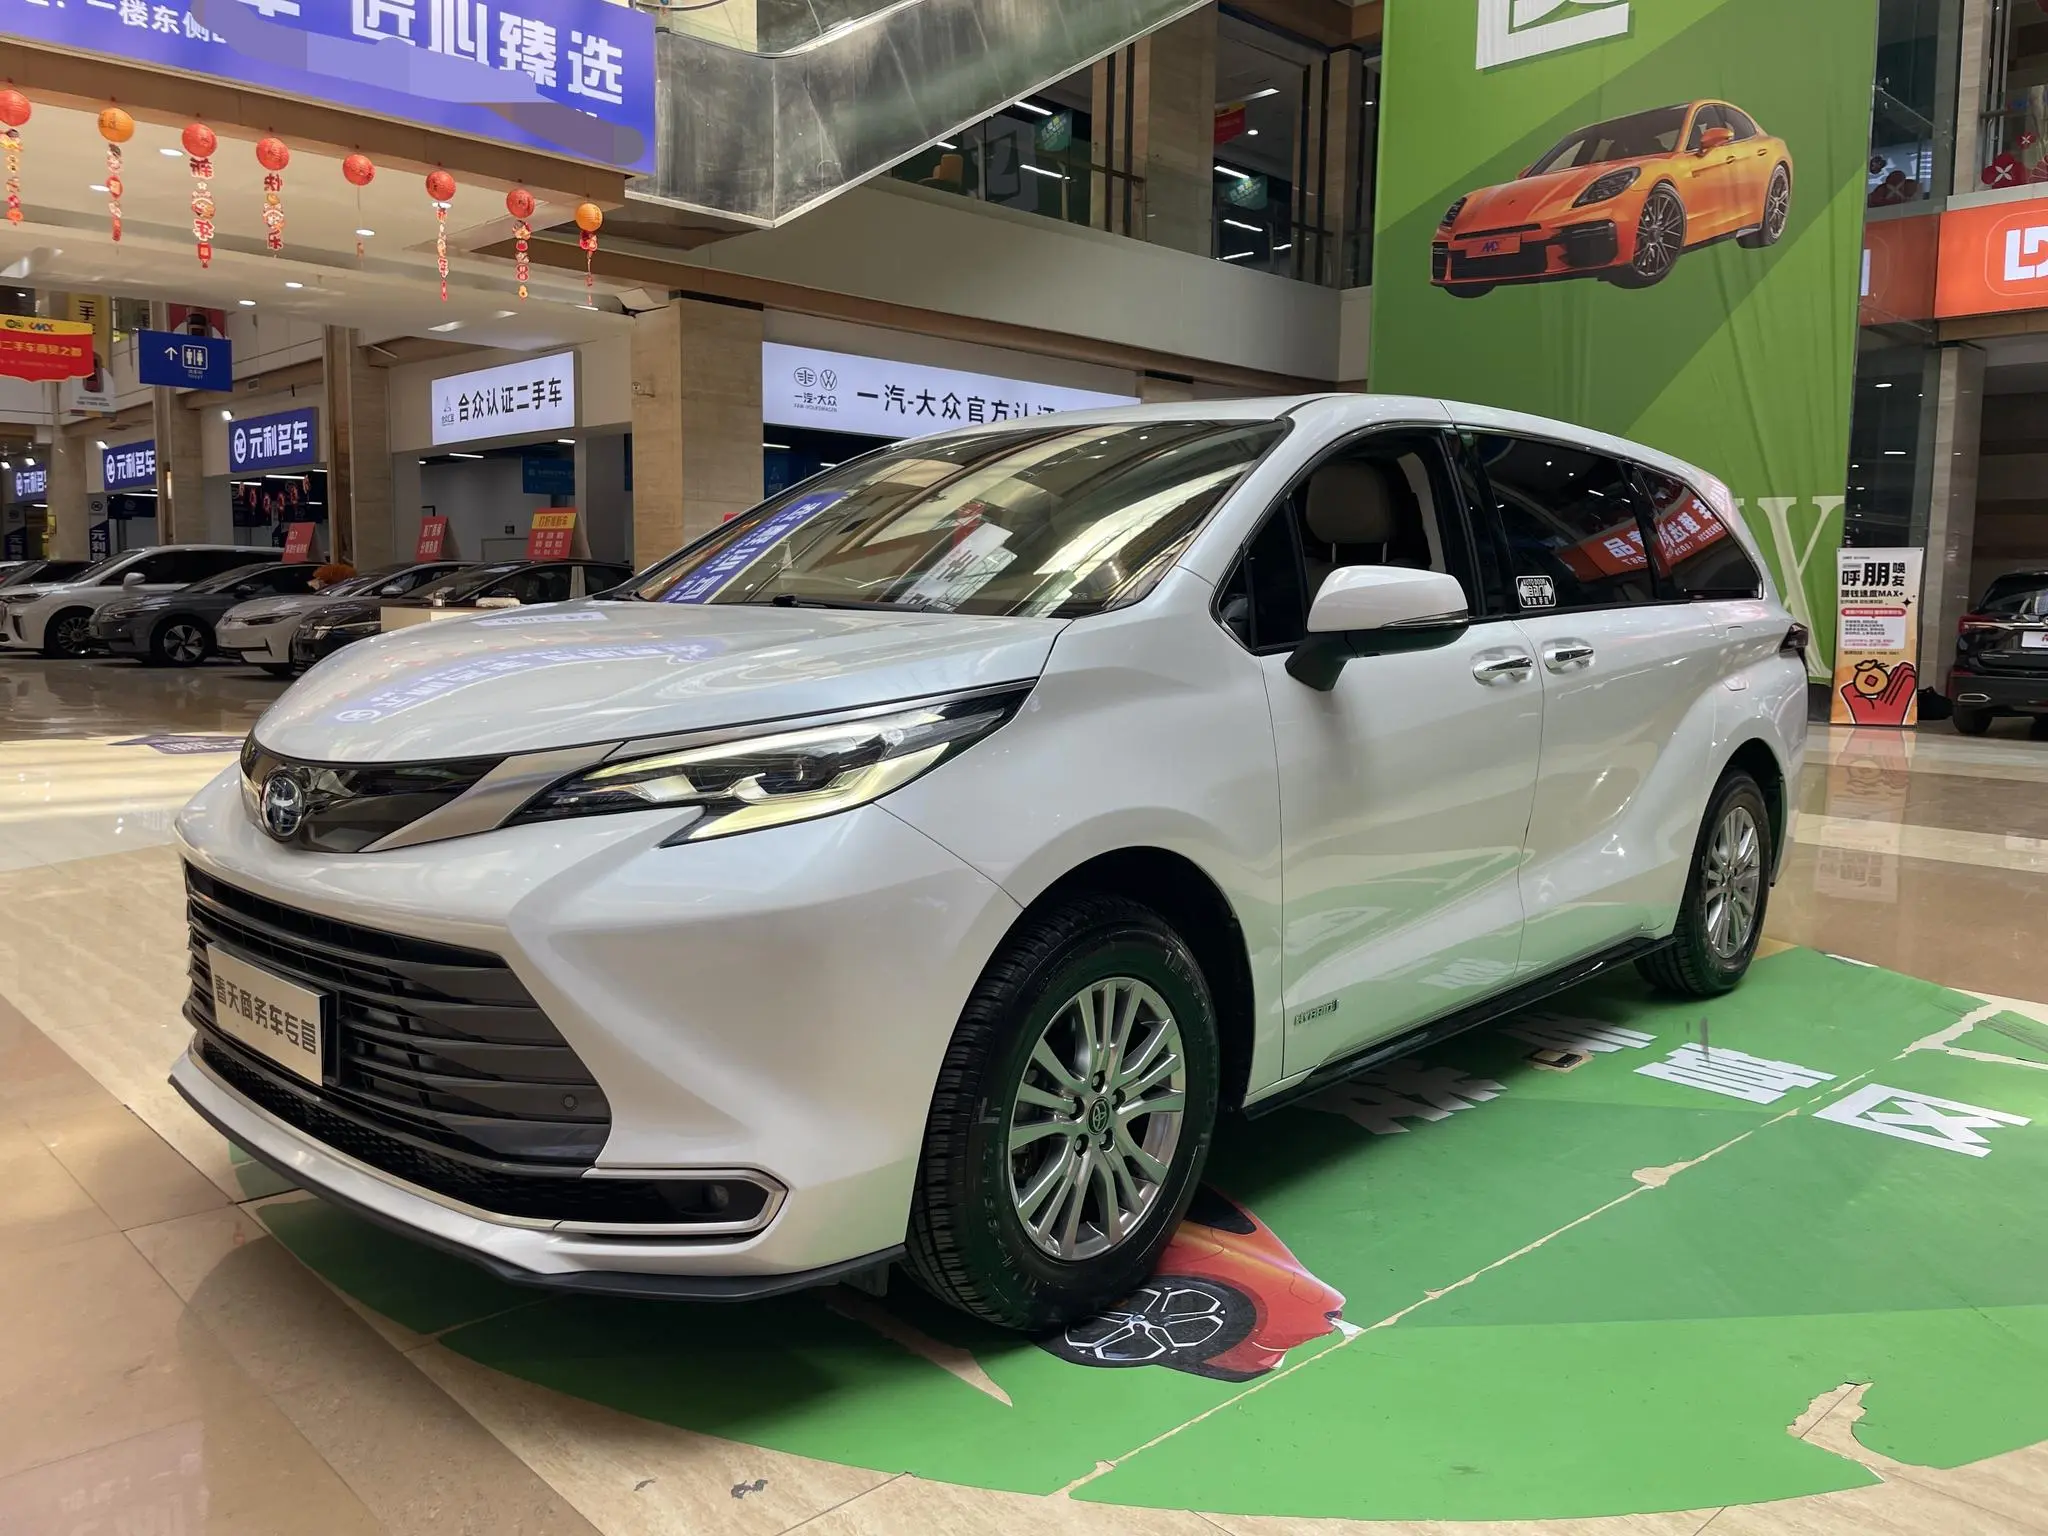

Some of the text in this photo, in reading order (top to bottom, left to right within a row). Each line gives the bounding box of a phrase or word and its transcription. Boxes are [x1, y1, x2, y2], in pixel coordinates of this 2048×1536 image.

[458, 377, 563, 422] 合众认证二手车
[857, 384, 1065, 424] 一汽-大众官方认
[250, 421, 308, 459] 元利名车
[117, 449, 156, 480] 元利名车
[214, 973, 317, 1056] 春天商务车专营
